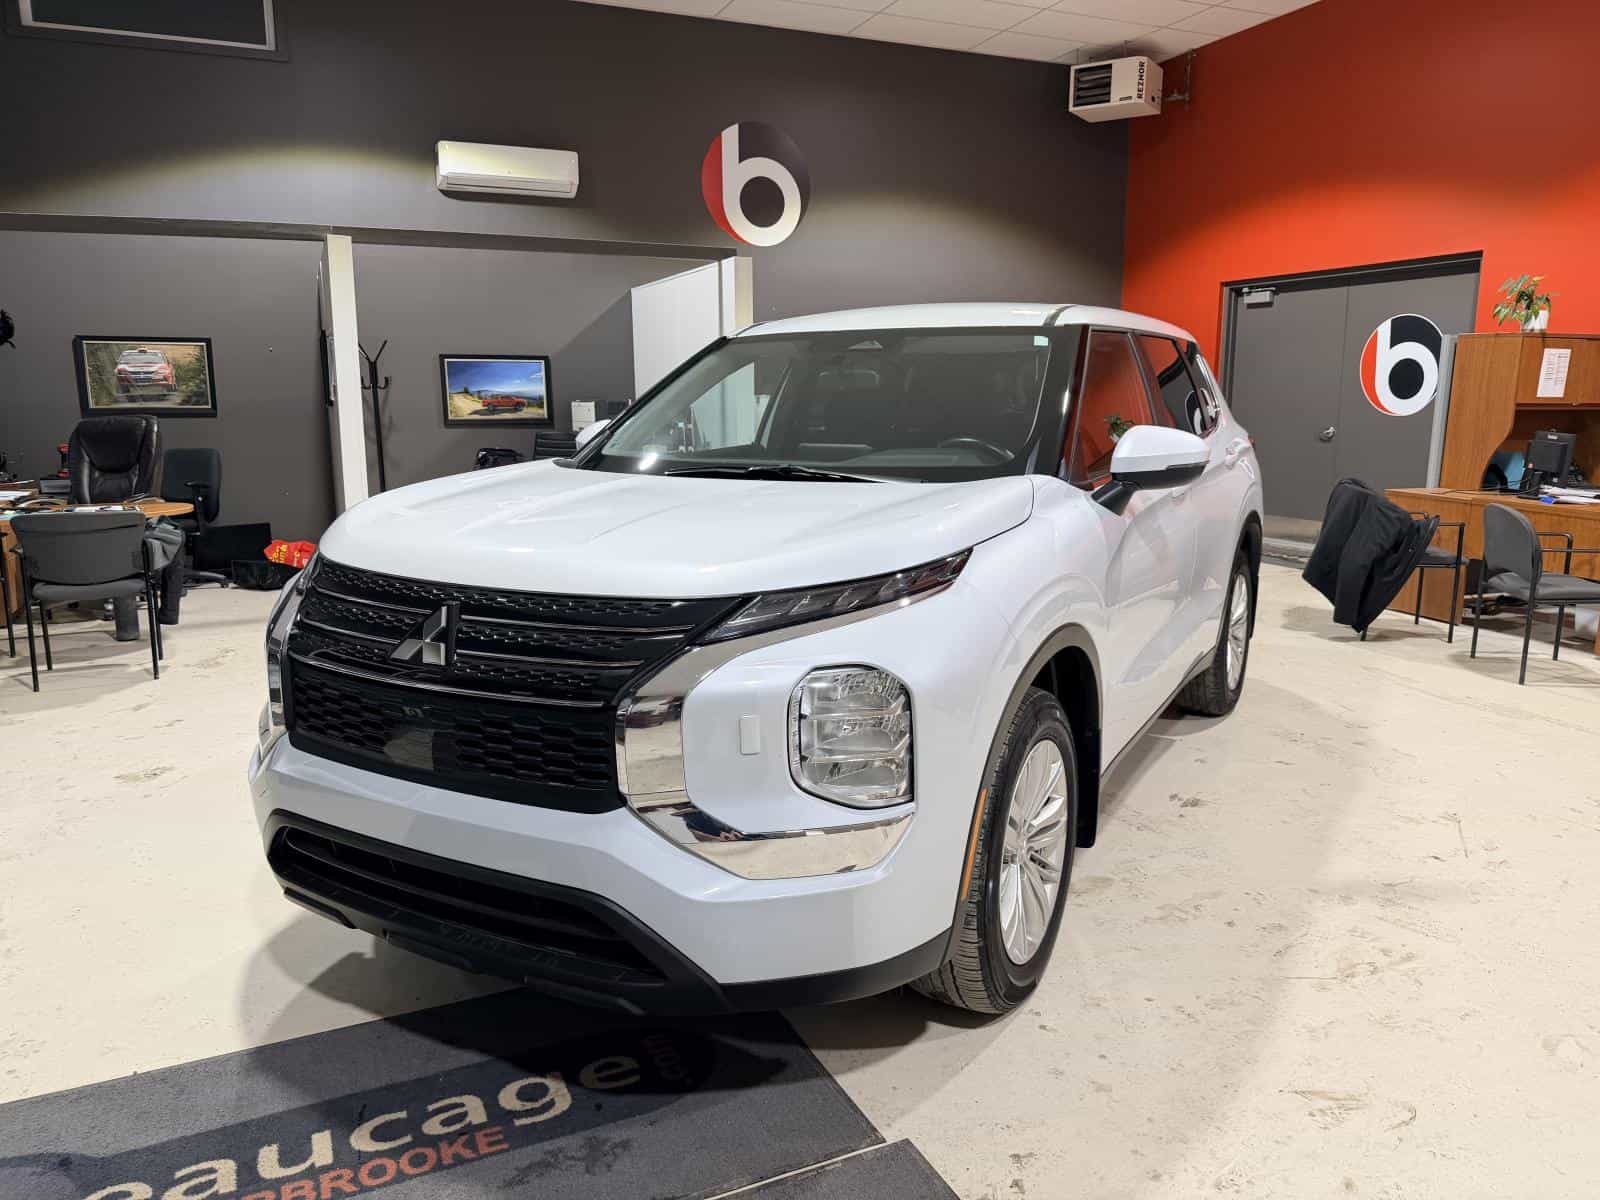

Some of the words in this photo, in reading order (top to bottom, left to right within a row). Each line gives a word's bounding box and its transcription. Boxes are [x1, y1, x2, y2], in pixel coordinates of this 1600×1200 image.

[1137, 61, 1145, 99] REZNOR
[721, 122, 802, 247] b
[1375, 318, 1439, 416] b
